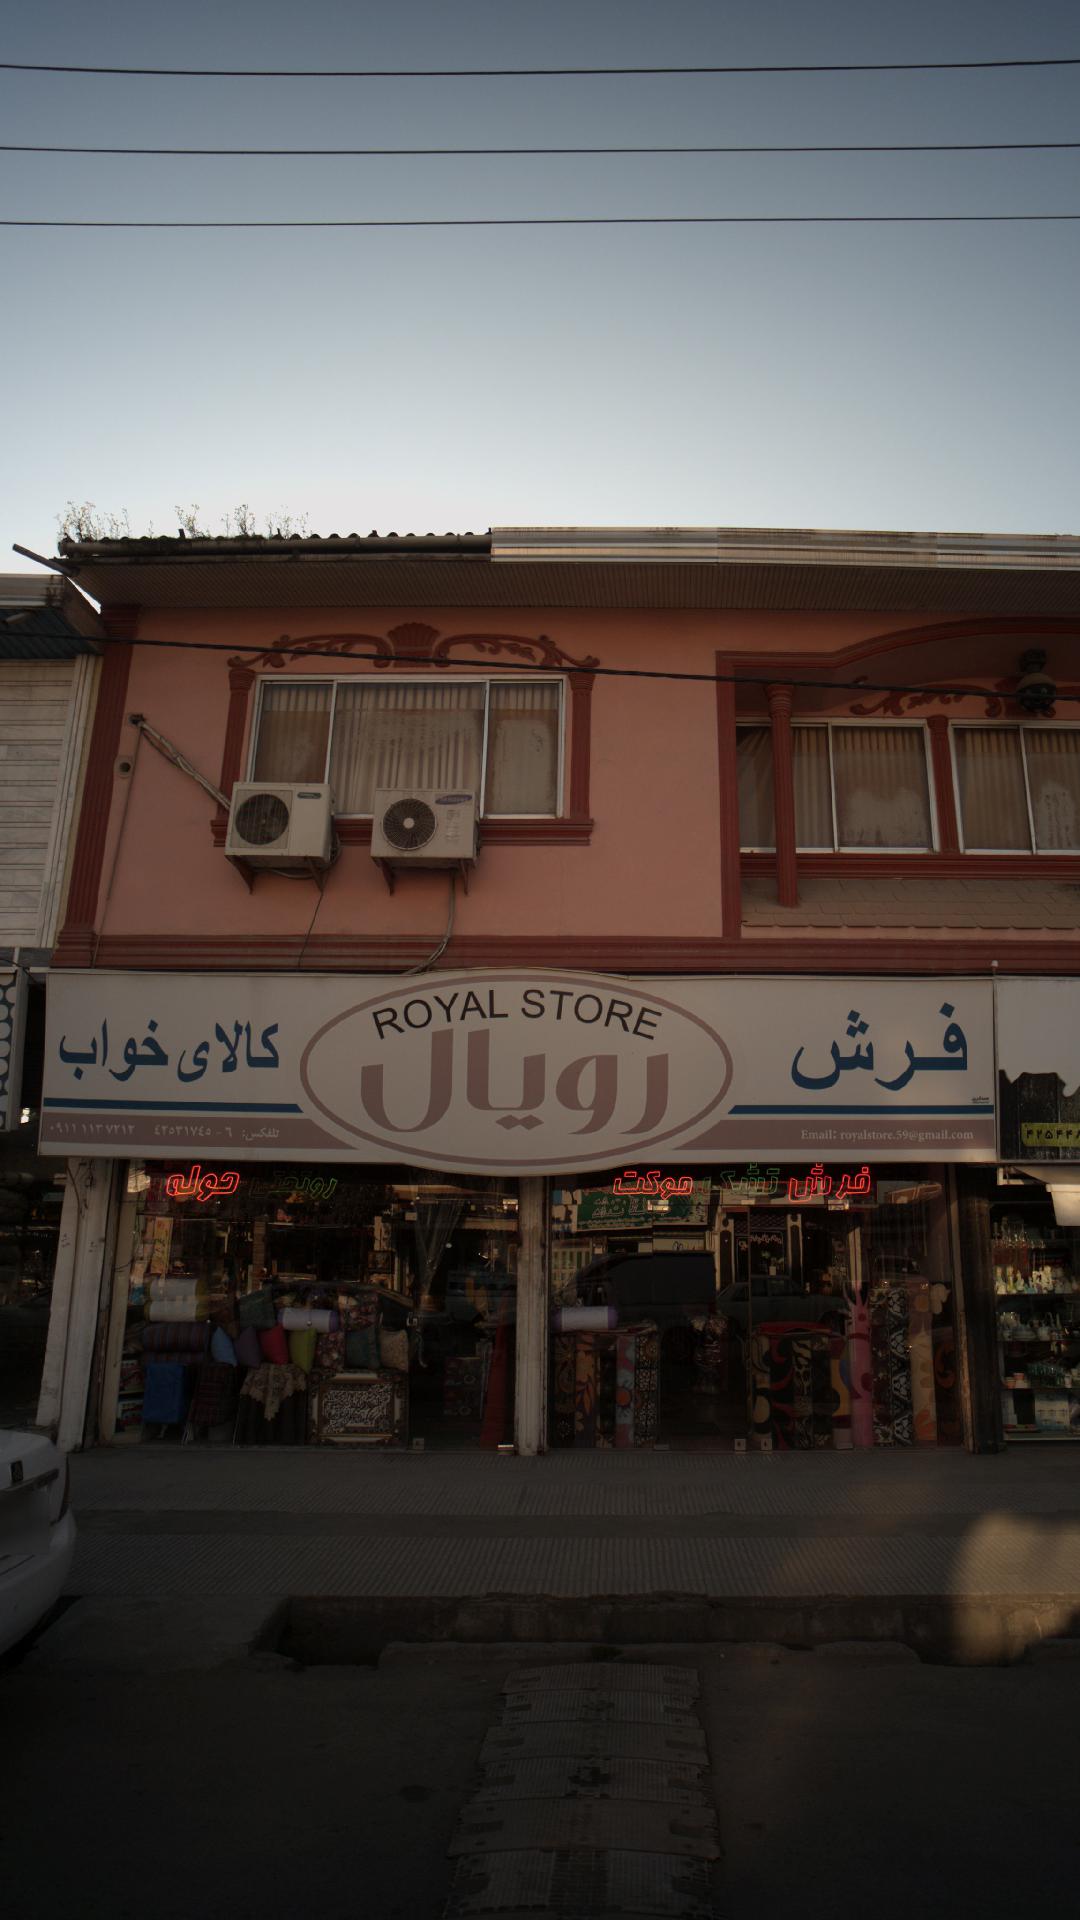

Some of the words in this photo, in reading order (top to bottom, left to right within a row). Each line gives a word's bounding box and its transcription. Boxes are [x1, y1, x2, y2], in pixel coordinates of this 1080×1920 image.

[372, 989, 508, 1040] ROYAL
[521, 989, 663, 1040] STORE
[59, 1018, 169, 1082] خواب
[177, 1019, 279, 1083] کالای
[791, 1002, 968, 1091] فرش
[360, 1028, 669, 1135] رویال
[800, 1129, 837, 1140] Email:
[166, 1164, 240, 1202] حوله
[612, 1170, 693, 1200] موکت
[788, 1162, 871, 1203] فرش
